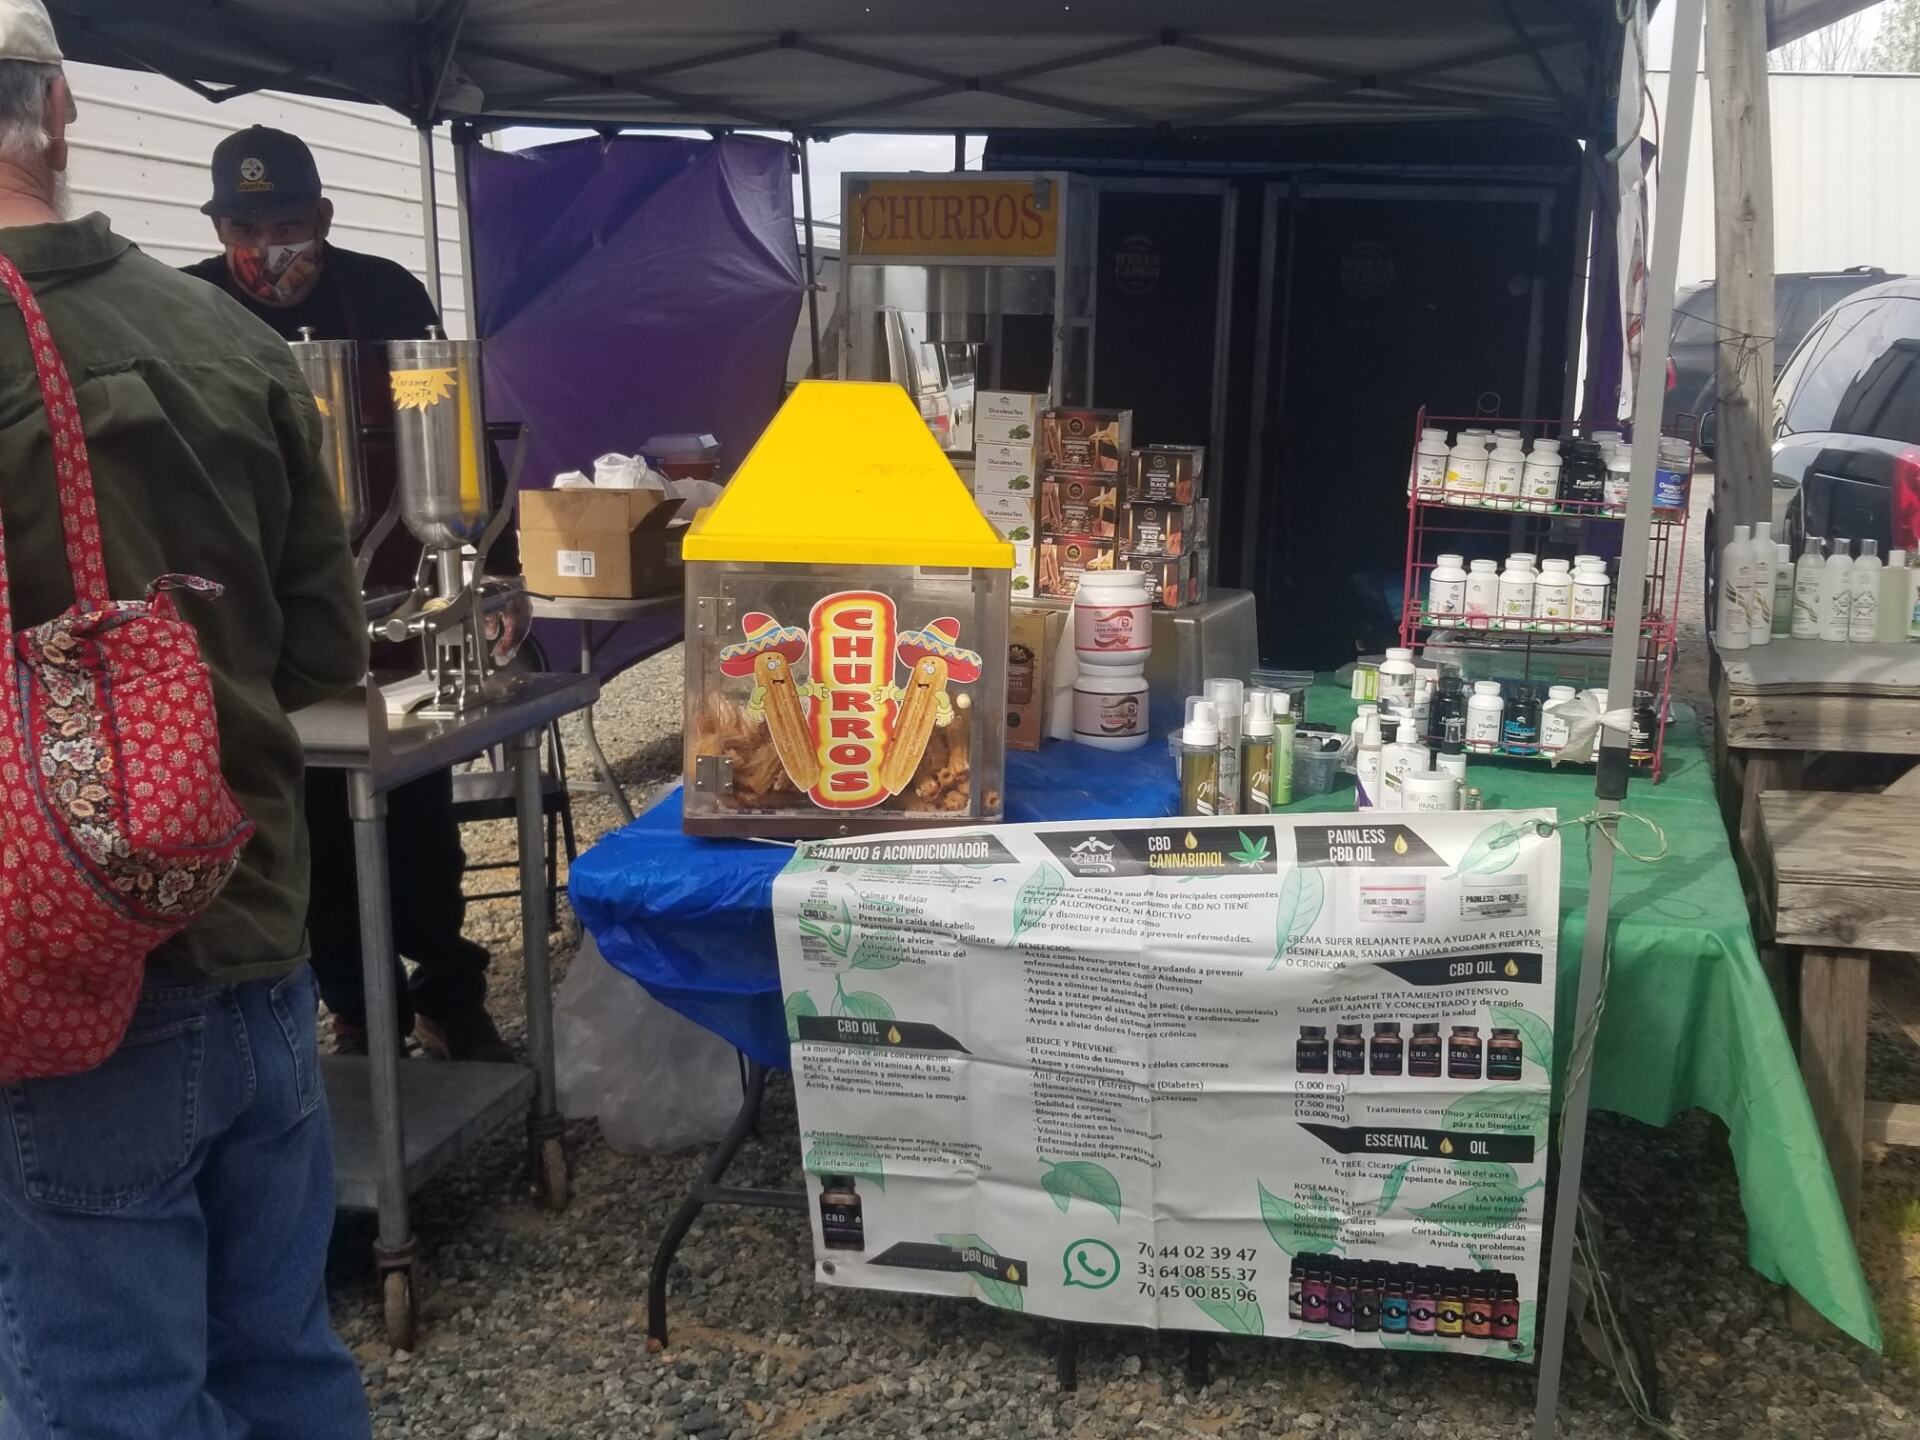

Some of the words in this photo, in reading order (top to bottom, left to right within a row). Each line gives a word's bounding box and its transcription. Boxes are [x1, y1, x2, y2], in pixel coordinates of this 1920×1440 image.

[863, 191, 1045, 243] CHURROS
[830, 610, 875, 793] CHURROS
[1148, 836, 1171, 851] CBD
[1327, 829, 1386, 844] PAINLESS
[810, 846, 869, 861] SHAMPOO
[883, 842, 989, 859] ACONDICIONADOR
[1329, 846, 1354, 862] CBD
[1356, 846, 1375, 862] OIL
[1149, 851, 1225, 869] CANNABIDIOL
[860, 891, 887, 900] Calmar
[899, 893, 928, 903] Relajar
[1170, 891, 1217, 901] principales
[1220, 891, 1279, 900] componentes
[859, 902, 894, 913] Hidratar
[905, 906, 924, 915] pelo
[1023, 896, 1058, 906] EFECTO
[1134, 907, 1143, 915] NI
[1145, 909, 1192, 920] ADICTIVO
[1172, 902, 1183, 910] de
[1185, 902, 1204, 910] CBD
[1206, 902, 1221, 910] NO
[1224, 902, 1249, 910] TIENE
[859, 913, 894, 926] Prevenir
[931, 920, 945, 929] del
[947, 920, 975, 931] cabello
[1056, 910, 1101, 922] disminuye
[1143, 920, 1160, 928] como
[860, 933, 896, 944] Prevenir
[897, 935, 905, 943] la
[907, 935, 935, 945] alvicie
[959, 934, 996, 945] brillante
[1094, 926, 1138, 937] ayudando
[1146, 930, 1184, 940] prevenir
[1186, 932, 1254, 944] enfermedades.
[1325, 937, 1353, 945] SUPER
[1355, 937, 1411, 946] RELAJANTE
[1413, 937, 1443, 945] PARA
[1444, 934, 1487, 944] AYUDAR
[1499, 928, 1541, 939] RELAJAR
[912, 947, 951, 957] bienestar
[953, 948, 967, 958] del
[1286, 947, 1359, 959] DESINFLAMAR,
[1361, 949, 1397, 958] SANAR
[1409, 946, 1449, 956] ALIVIAR
[1499, 940, 1544, 950] FUERTES,
[888, 953, 926, 965] cabelludo
[1052, 953, 1077, 962] como
[1078, 955, 1150, 971] Neuro-protector
[1152, 965, 1197, 975] ayudando
[1206, 968, 1244, 978] prevenir
[1024, 959, 1084, 972] enfermedades
[1086, 966, 1131, 978] cerebrales
[1449, 962, 1473, 977] CBD
[1476, 960, 1496, 975] OIL
[1064, 980, 1098, 992] eliminar
[1110, 986, 1148, 1000] ansiedad
[1081, 973, 1132, 987] crecimiento
[1155, 983, 1194, 994] (huesos)
[1065, 991, 1090, 1000] tratar
[1092, 993, 1136, 1008] problemas
[1311, 996, 1342, 1005] Aceite
[1344, 992, 1378, 1002] Natural
[1380, 990, 1453, 999] TRATAMIENTO
[1455, 987, 1509, 997] INTENSIVO
[1065, 1001, 1102, 1013] proteger
[1114, 1007, 1146, 1019] sistema
[1297, 1005, 1327, 1014] SUPER
[1329, 1003, 1384, 1013] RELAJANTE
[1394, 998, 1470, 1010] CONCENTRADO
[1479, 998, 1491, 1006] de
[1492, 999, 1524, 1009] rapido
[1372, 1013, 1394, 1021] para
[1395, 1011, 1439, 1021] recuperar
[1451, 1009, 1476, 1017] salud
[837, 1019, 859, 1033] CBD
[862, 1022, 880, 1035] OIL
[1065, 1021, 1092, 1031] aliviar
[1094, 1024, 1126, 1035] dolores
[1119, 1017, 1151, 1029] sistema
[813, 1045, 846, 1055] moringa
[1026, 1036, 1063, 1046] REDUCE
[1072, 1039, 1118, 1054] PREVIENE:
[874, 1059, 913, 1071] vitaminas
[1040, 1048, 1090, 1060] crecimiento
[1092, 1054, 1102, 1062] de
[1104, 1055, 1139, 1068] tumores
[1180, 1061, 1229, 1069] cancerosas
[836, 1066, 878, 1077] nutrientes
[1071, 1063, 1125, 1076] convulsiones
[1098, 1079, 1136, 1093] (Estress)
[1157, 1080, 1204, 1090] (Diabetes)
[1294, 1081, 1324, 1091] (5.000
[1326, 1082, 1345, 1092] mg)
[1077, 1103, 1111, 1114] corporal
[1295, 1109, 1330, 1120] (10.000
[1326, 1103, 1345, 1113] mg)
[1366, 1105, 1422, 1115] Tratamiento
[1453, 1121, 1475, 1130] para
[1488, 1121, 1531, 1131] bienestar
[1036, 1145, 1079, 1158] (Esclerosis
[1365, 1134, 1428, 1150] ESSENTIAL
[1470, 1141, 1489, 1155] OIL
[1320, 1157, 1338, 1166] TEA
[1341, 1161, 1366, 1169] TREE:
[1412, 1165, 1442, 1176] Limpia
[1454, 1168, 1470, 1178] piel
[1334, 1169, 1356, 1178] Evita
[1459, 1179, 1497, 1188] insectos
[1294, 1182, 1348, 1196] ROSEMARY:
[1294, 1193, 1323, 1202] Ayuda
[1294, 1213, 1327, 1224] Dolores
[1412, 1227, 1461, 1240] Cortaduras
[1471, 1231, 1526, 1242] quemaduras
[1137, 1242, 1154, 1258] 70
[1159, 1245, 1179, 1258] 44
[1184, 1246, 1205, 1259] 02
[1211, 1246, 1231, 1260] 39
[1236, 1248, 1256, 1261] 47
[1430, 1239, 1465, 1248] Ayuda
[1480, 1243, 1525, 1252] problemas
[961, 1249, 981, 1263] CBD
[982, 1255, 998, 1270] OIL
[1138, 1262, 1154, 1278] 33
[1160, 1266, 1179, 1278] 64
[1184, 1266, 1205, 1278] 08
[1211, 1266, 1230, 1279] 55
[1237, 1268, 1257, 1281] 37
[1137, 1282, 1155, 1297] 70
[1160, 1286, 1179, 1298] 45
[1185, 1286, 1205, 1298] 00
[1211, 1287, 1230, 1300] 85
[1237, 1289, 1257, 1302] 96
